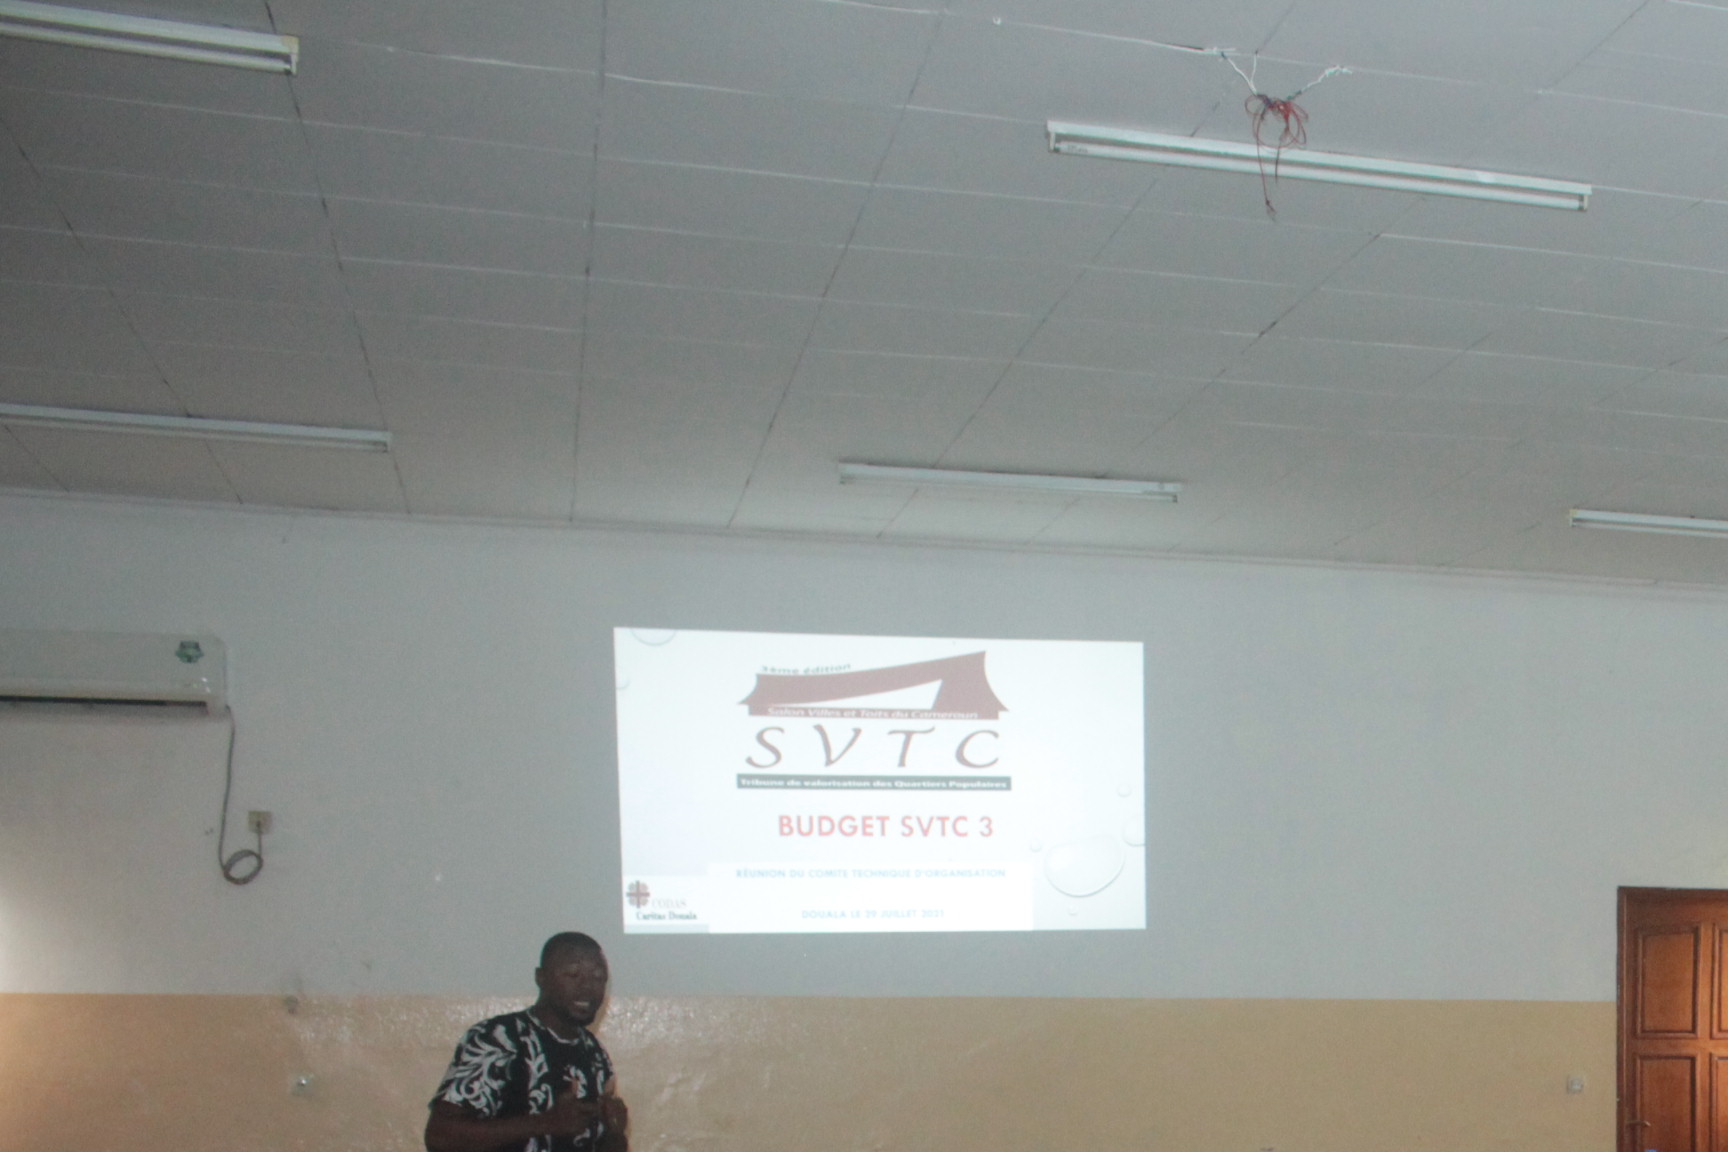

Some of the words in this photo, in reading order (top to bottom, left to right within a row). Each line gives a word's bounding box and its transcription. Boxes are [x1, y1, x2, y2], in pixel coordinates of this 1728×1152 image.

[808, 708, 840, 718] Villes
[911, 711, 979, 721] Cameroun
[741, 778, 784, 787] Tribune
[894, 780, 947, 789] Quartiers
[948, 780, 1007, 790] Populaires
[778, 815, 890, 837] BUDGET
[900, 815, 969, 838] SVTC
[980, 816, 994, 838] 3
[789, 869, 804, 878] DU
[851, 869, 911, 878] TECHNIQUE
[801, 909, 847, 918] DOUALA
